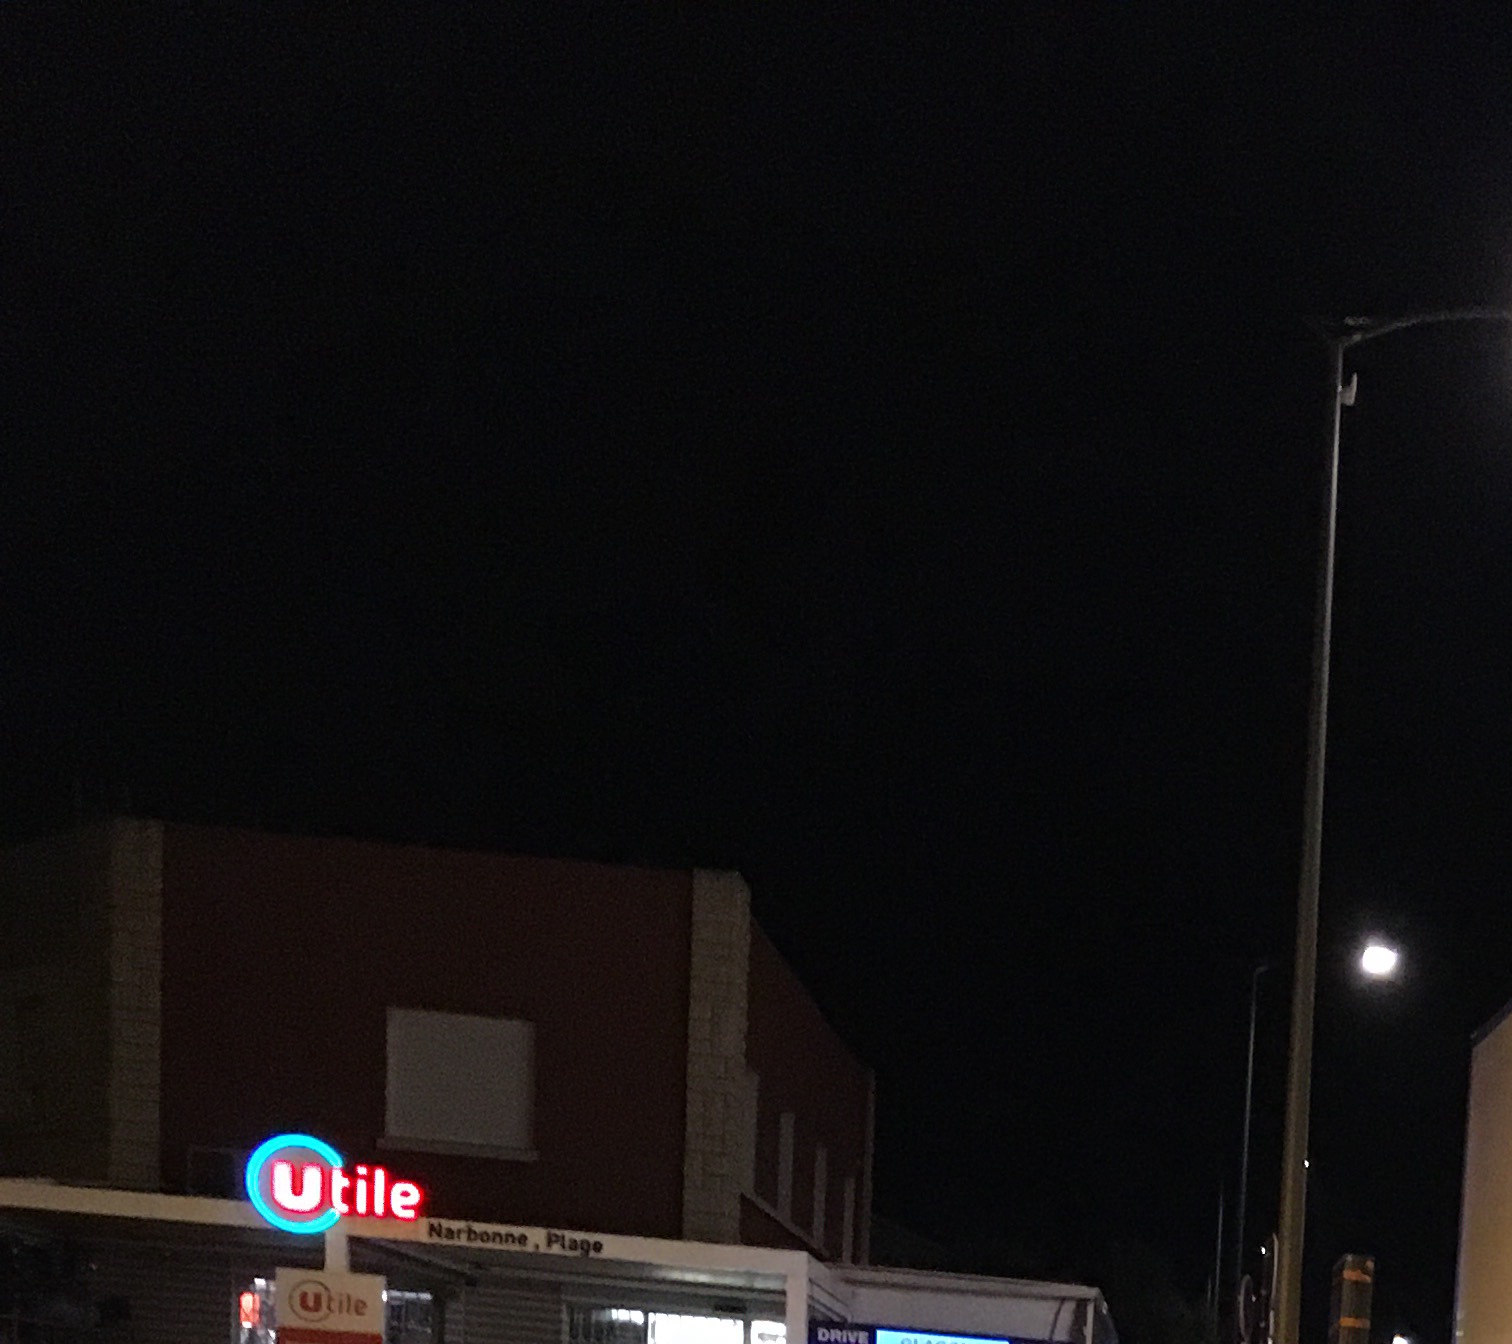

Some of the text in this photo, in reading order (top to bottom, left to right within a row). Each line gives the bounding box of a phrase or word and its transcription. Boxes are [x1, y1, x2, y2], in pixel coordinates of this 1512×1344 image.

[271, 1160, 424, 1221] Utile
[546, 1230, 604, 1256] Plage
[299, 1290, 368, 1317] Utile
[817, 1327, 869, 1344] DRIVE
